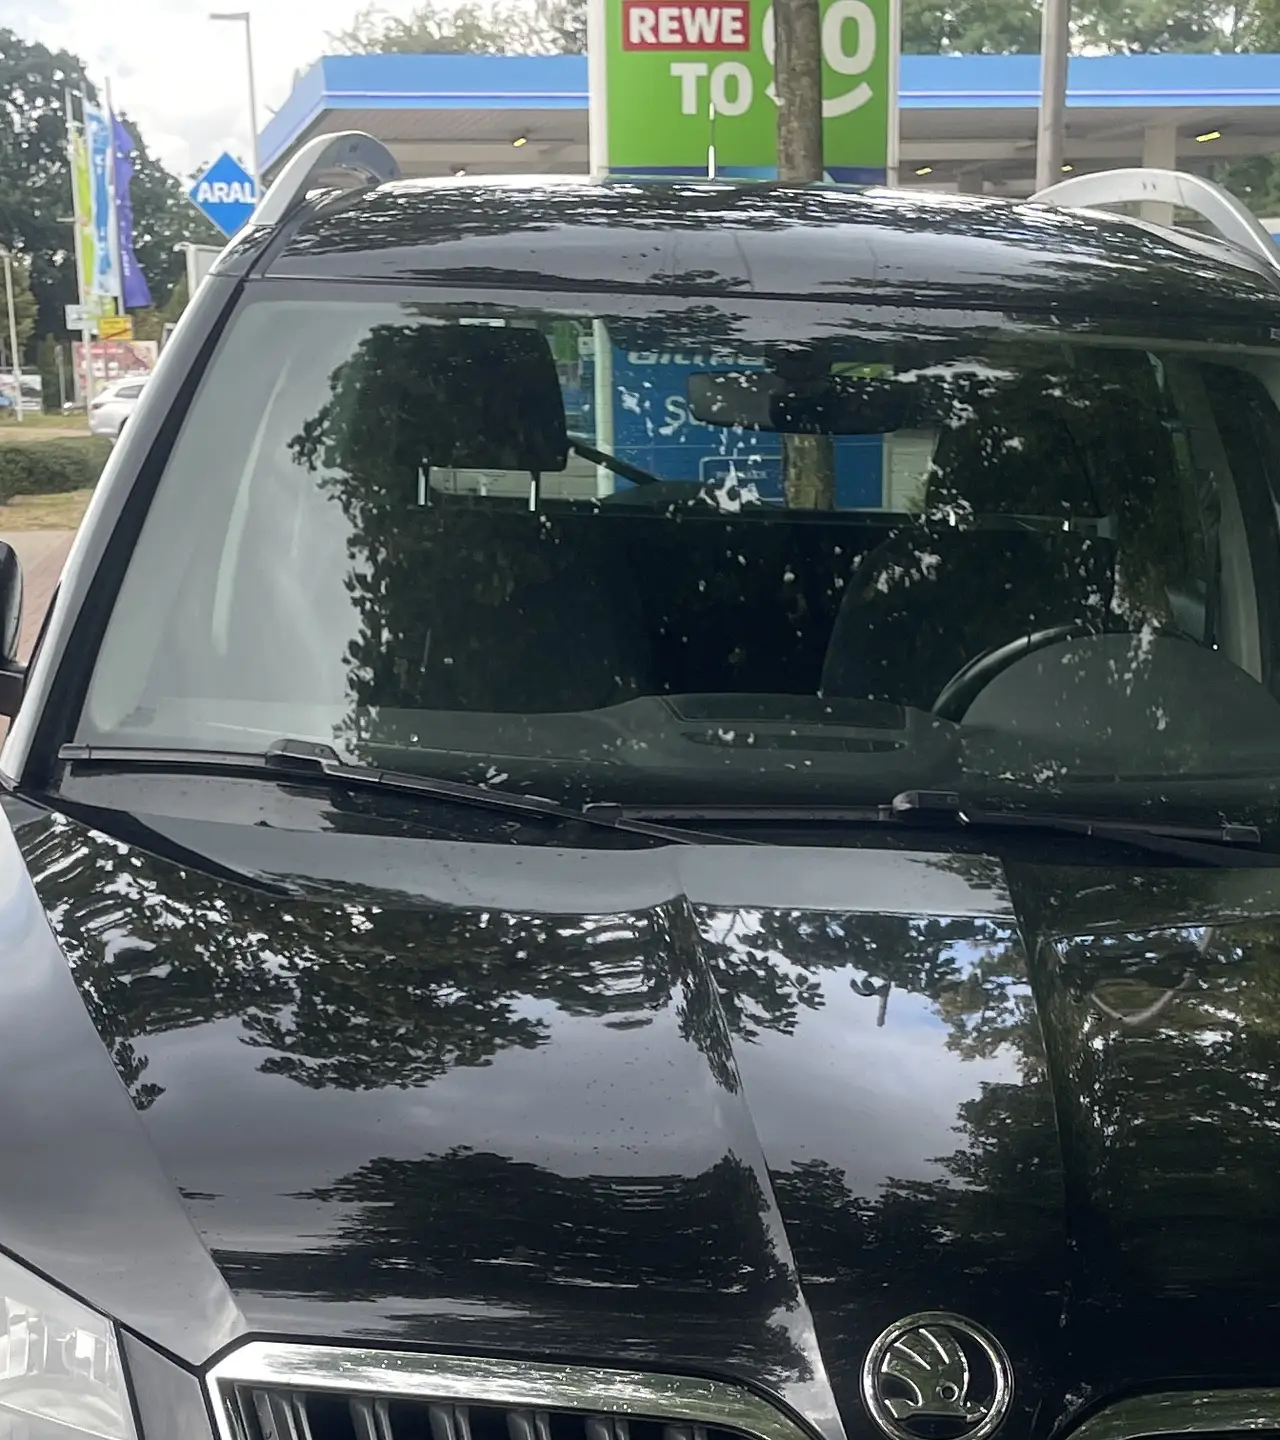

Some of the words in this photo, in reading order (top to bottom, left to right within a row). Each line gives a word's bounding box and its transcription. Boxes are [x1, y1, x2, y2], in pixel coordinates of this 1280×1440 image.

[628, 7, 746, 44] REWE
[762, 0, 876, 75] O
[670, 61, 753, 117] TO
[197, 181, 257, 204] ARAL
